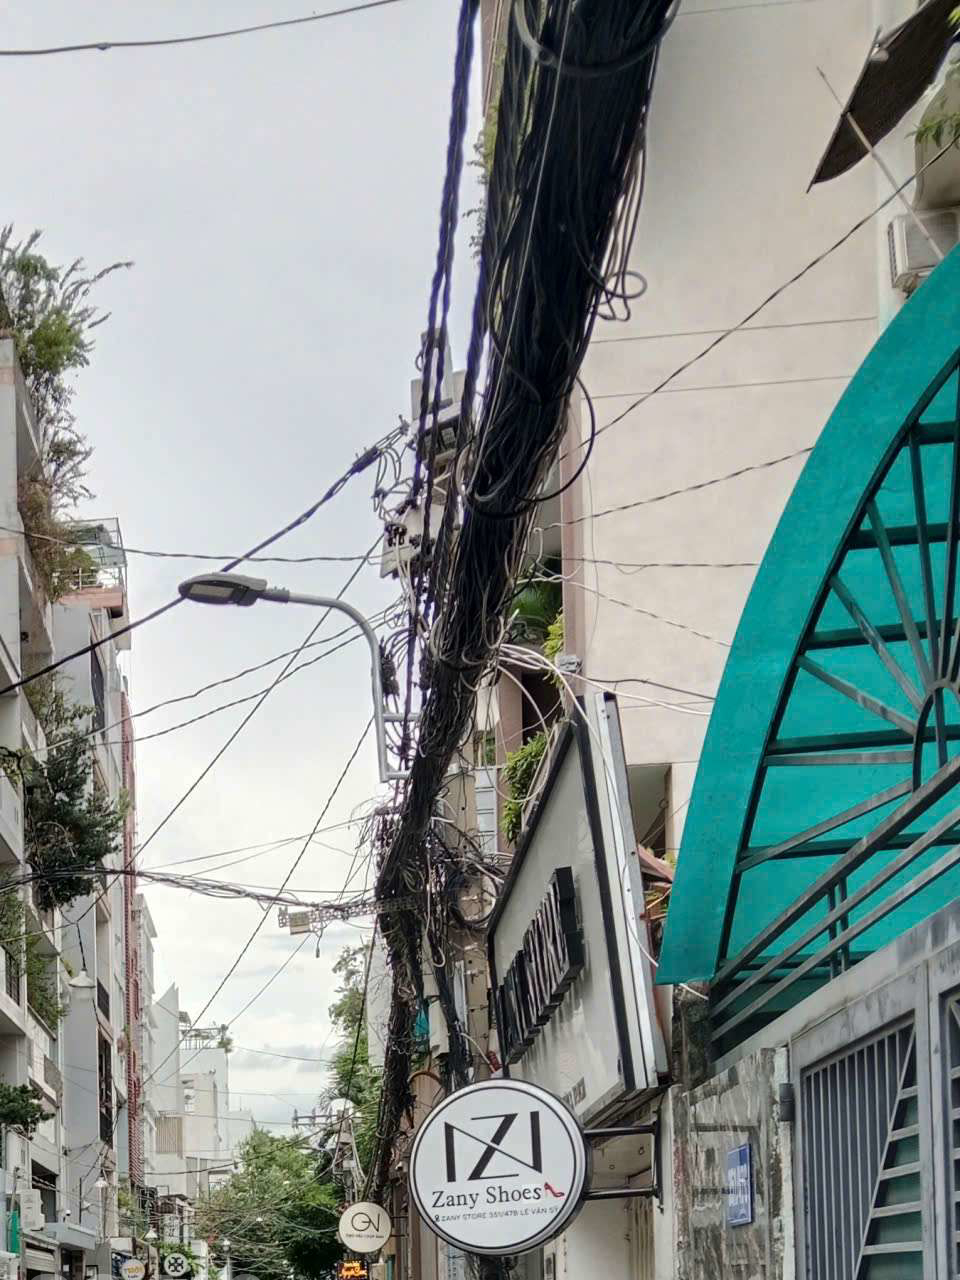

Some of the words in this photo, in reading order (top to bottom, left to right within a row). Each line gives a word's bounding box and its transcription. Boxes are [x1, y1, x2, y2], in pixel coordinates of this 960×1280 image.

[432, 1191, 480, 1209] Zany
[486, 1185, 542, 1204] Shoes
[462, 1211, 487, 1220] STORE
